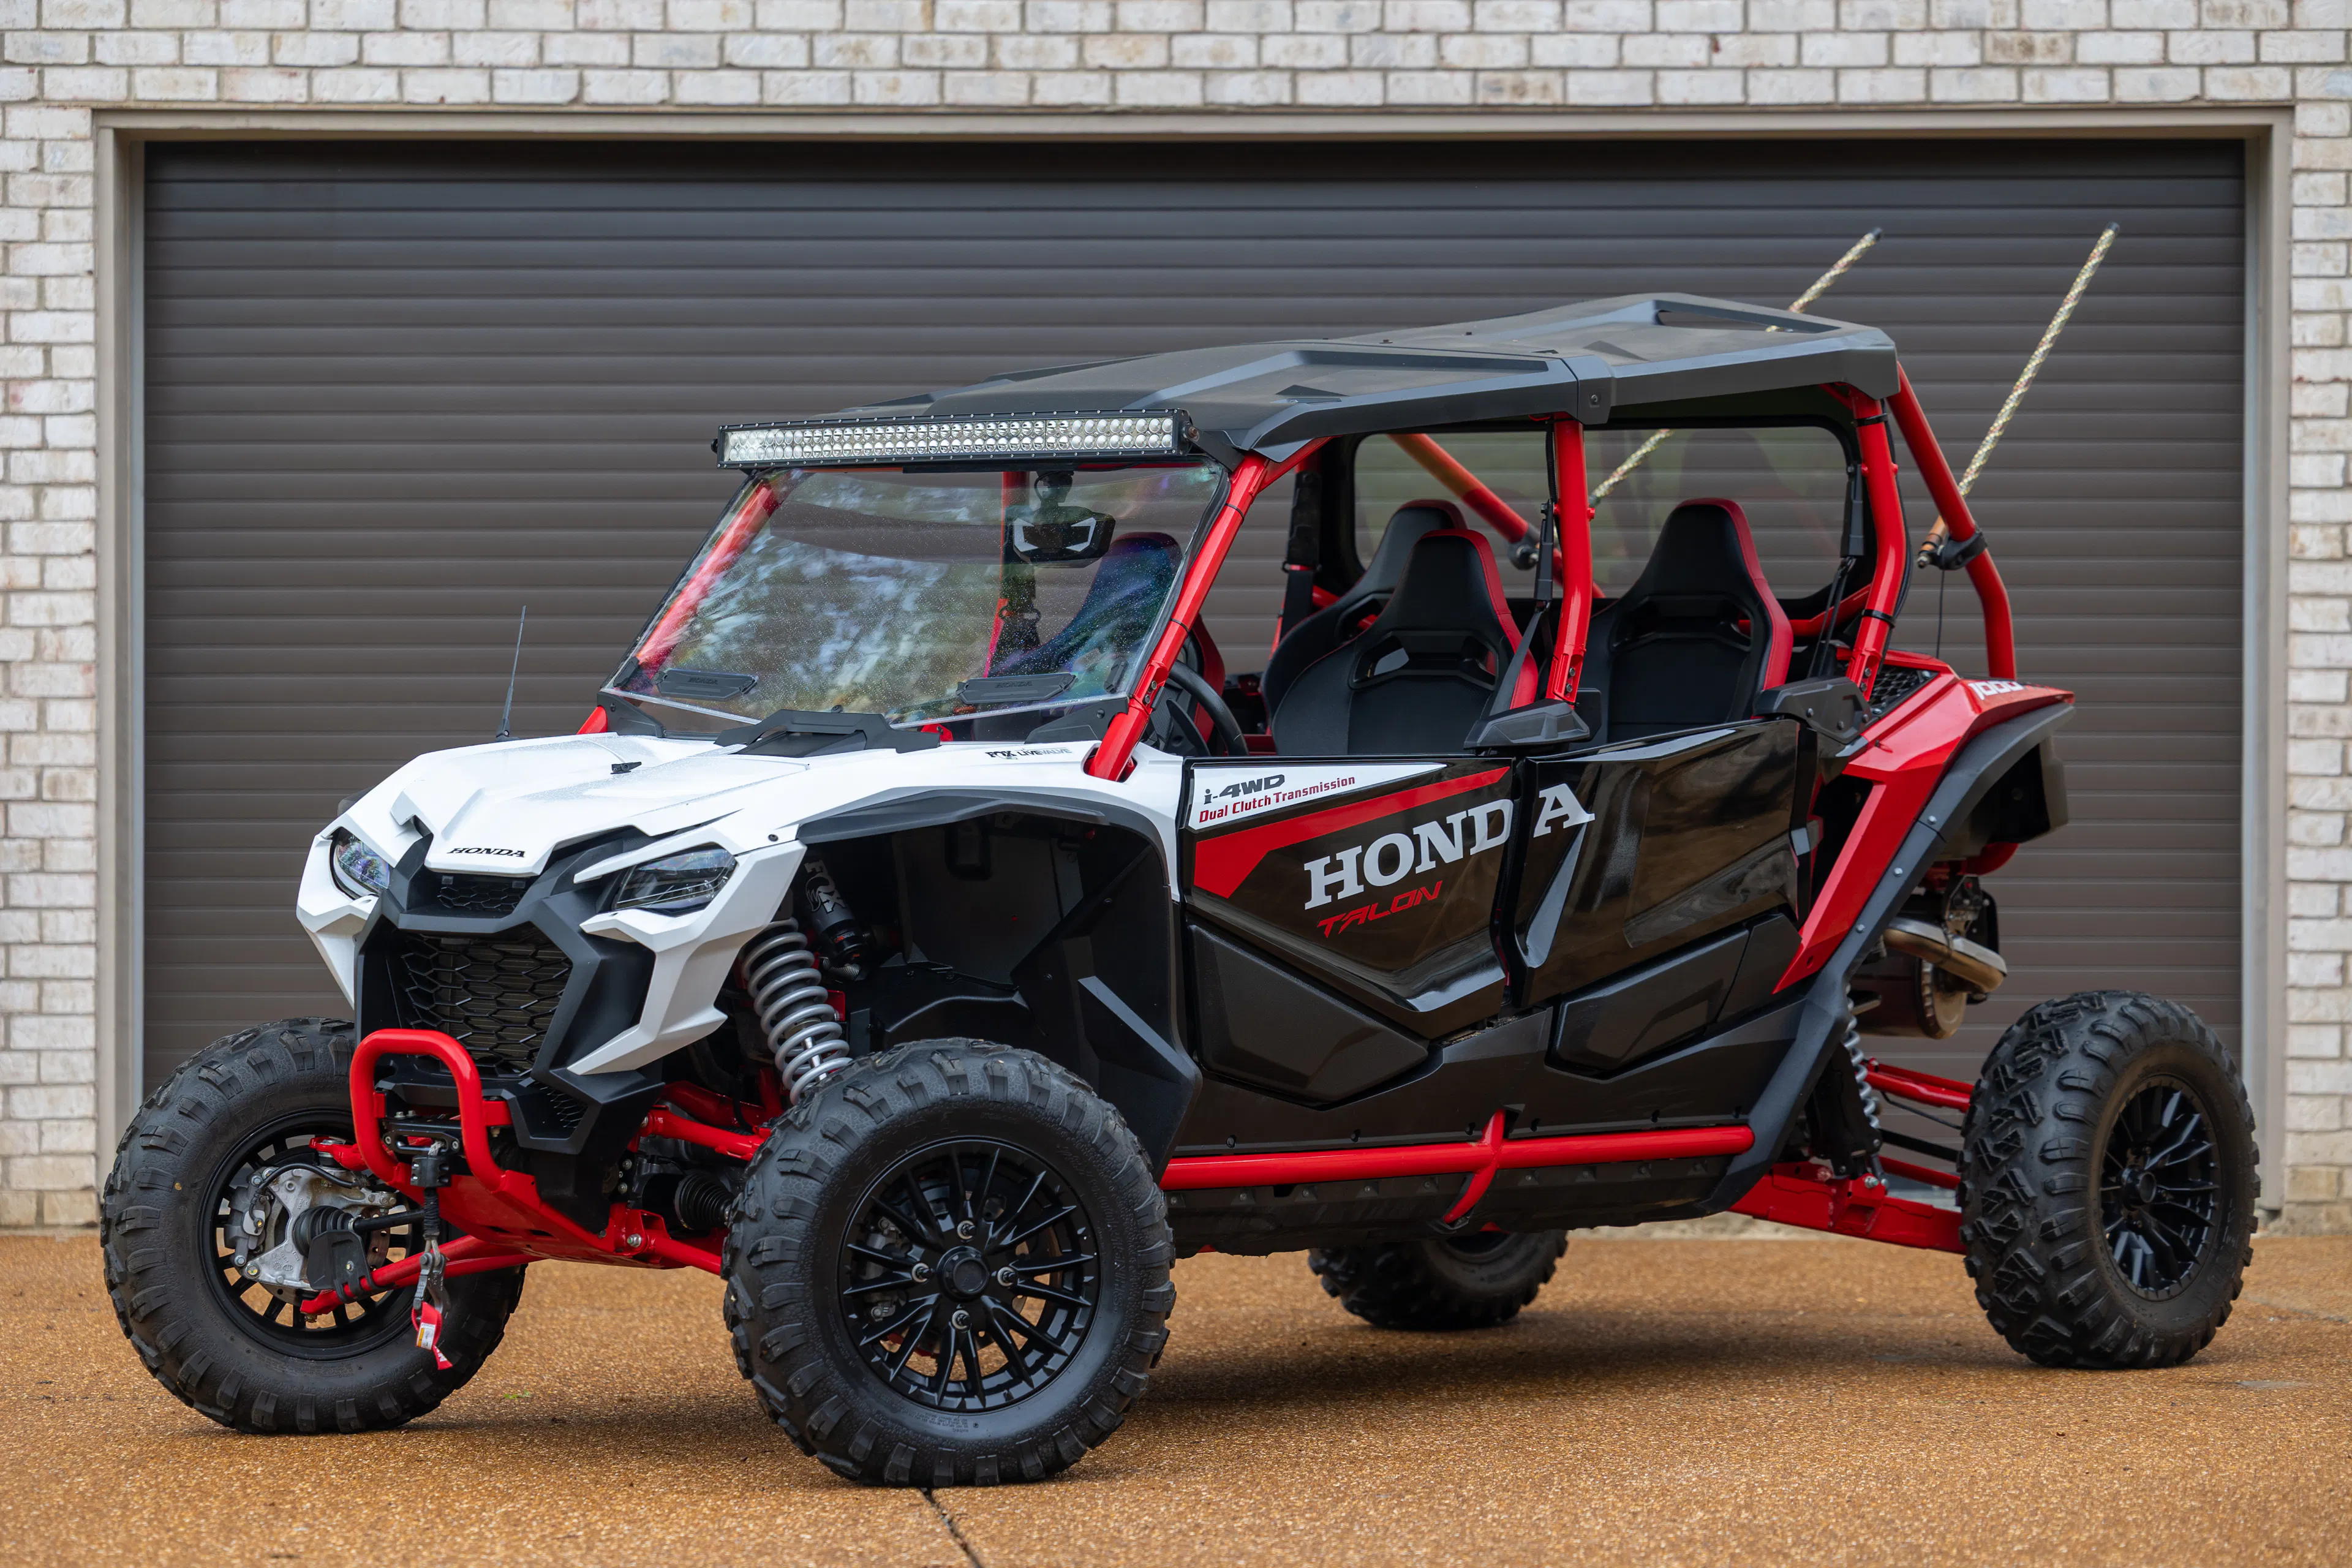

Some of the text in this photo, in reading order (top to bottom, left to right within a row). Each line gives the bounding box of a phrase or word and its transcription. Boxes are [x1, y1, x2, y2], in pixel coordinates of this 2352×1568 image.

[1968, 680, 2024, 701] 1000
[985, 750, 1017, 759] FOX
[1199, 776, 1355, 823] Dual Clutch Transmission
[1204, 774, 1285, 805] i-4WD
[447, 848, 526, 858] HONDA
[1303, 783, 1596, 910] HONDA
[804, 859, 847, 914] FOX
[1316, 880, 1442, 938] TALON
